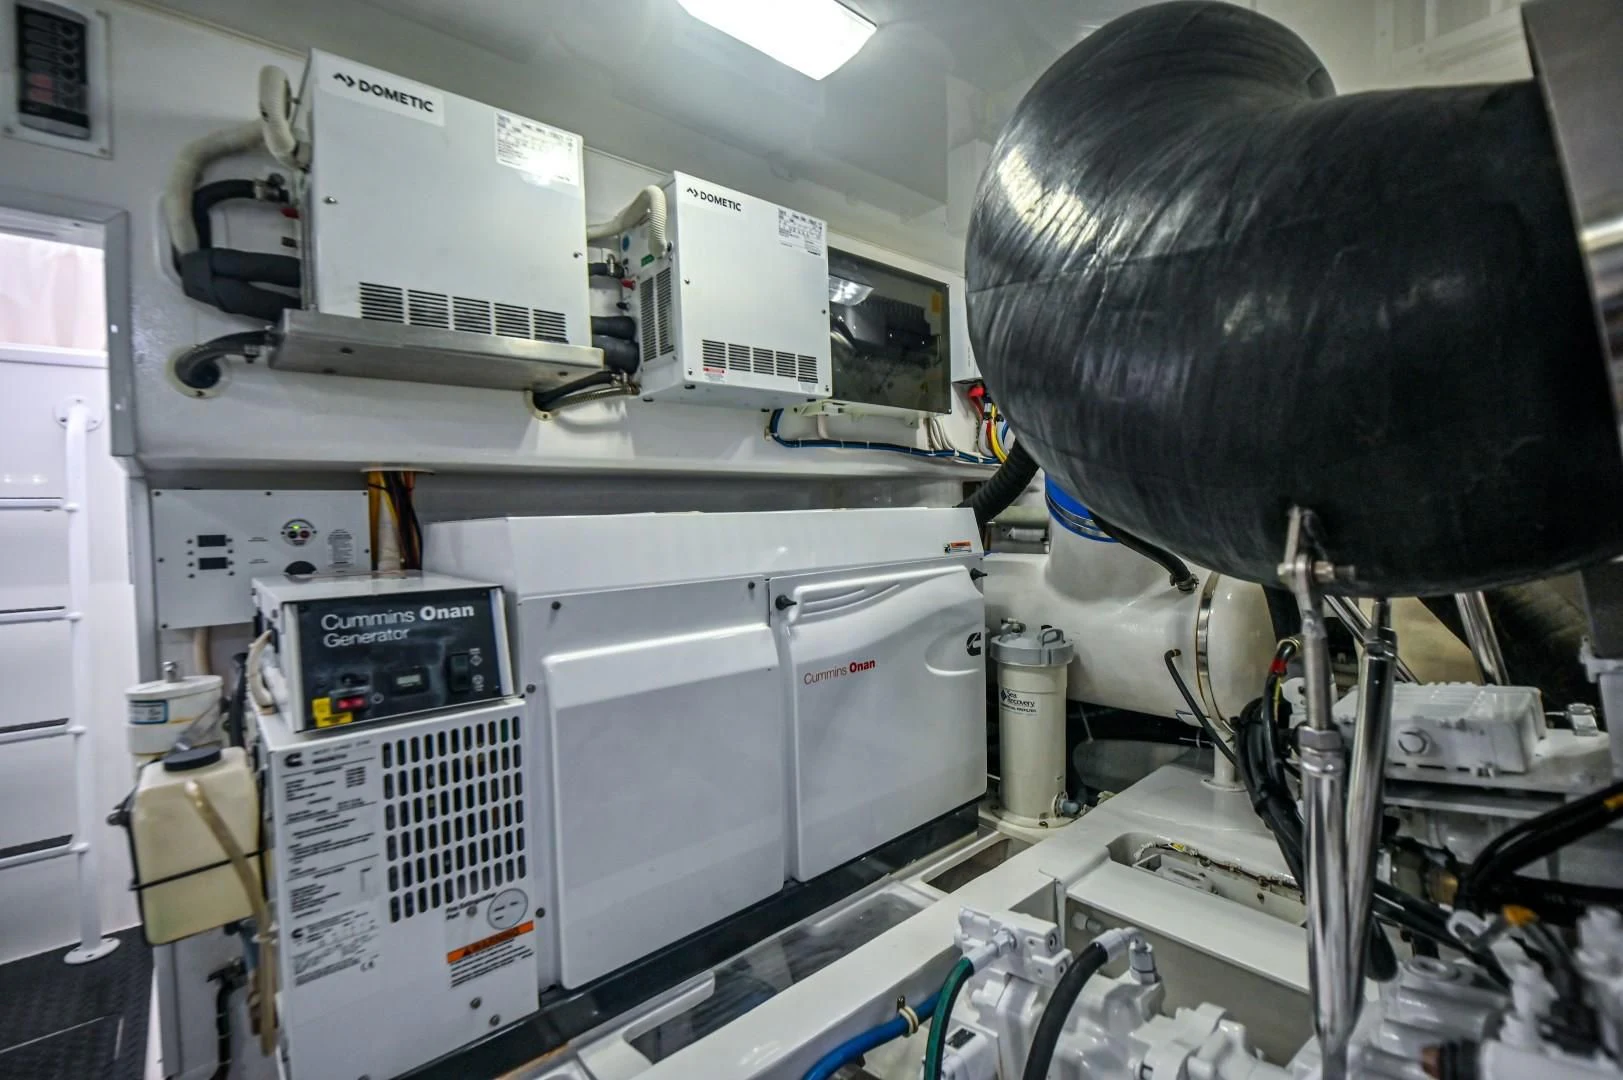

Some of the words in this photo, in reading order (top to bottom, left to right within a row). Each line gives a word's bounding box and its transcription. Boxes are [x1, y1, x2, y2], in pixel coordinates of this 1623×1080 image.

[358, 79, 434, 112] DOMETIC
[700, 191, 742, 212] DOMETIC
[321, 609, 415, 629] Cummins
[420, 605, 475, 621] Onan
[323, 628, 410, 648] Generator
[803, 666, 848, 685] Cummins
[849, 659, 876, 673] Onan
